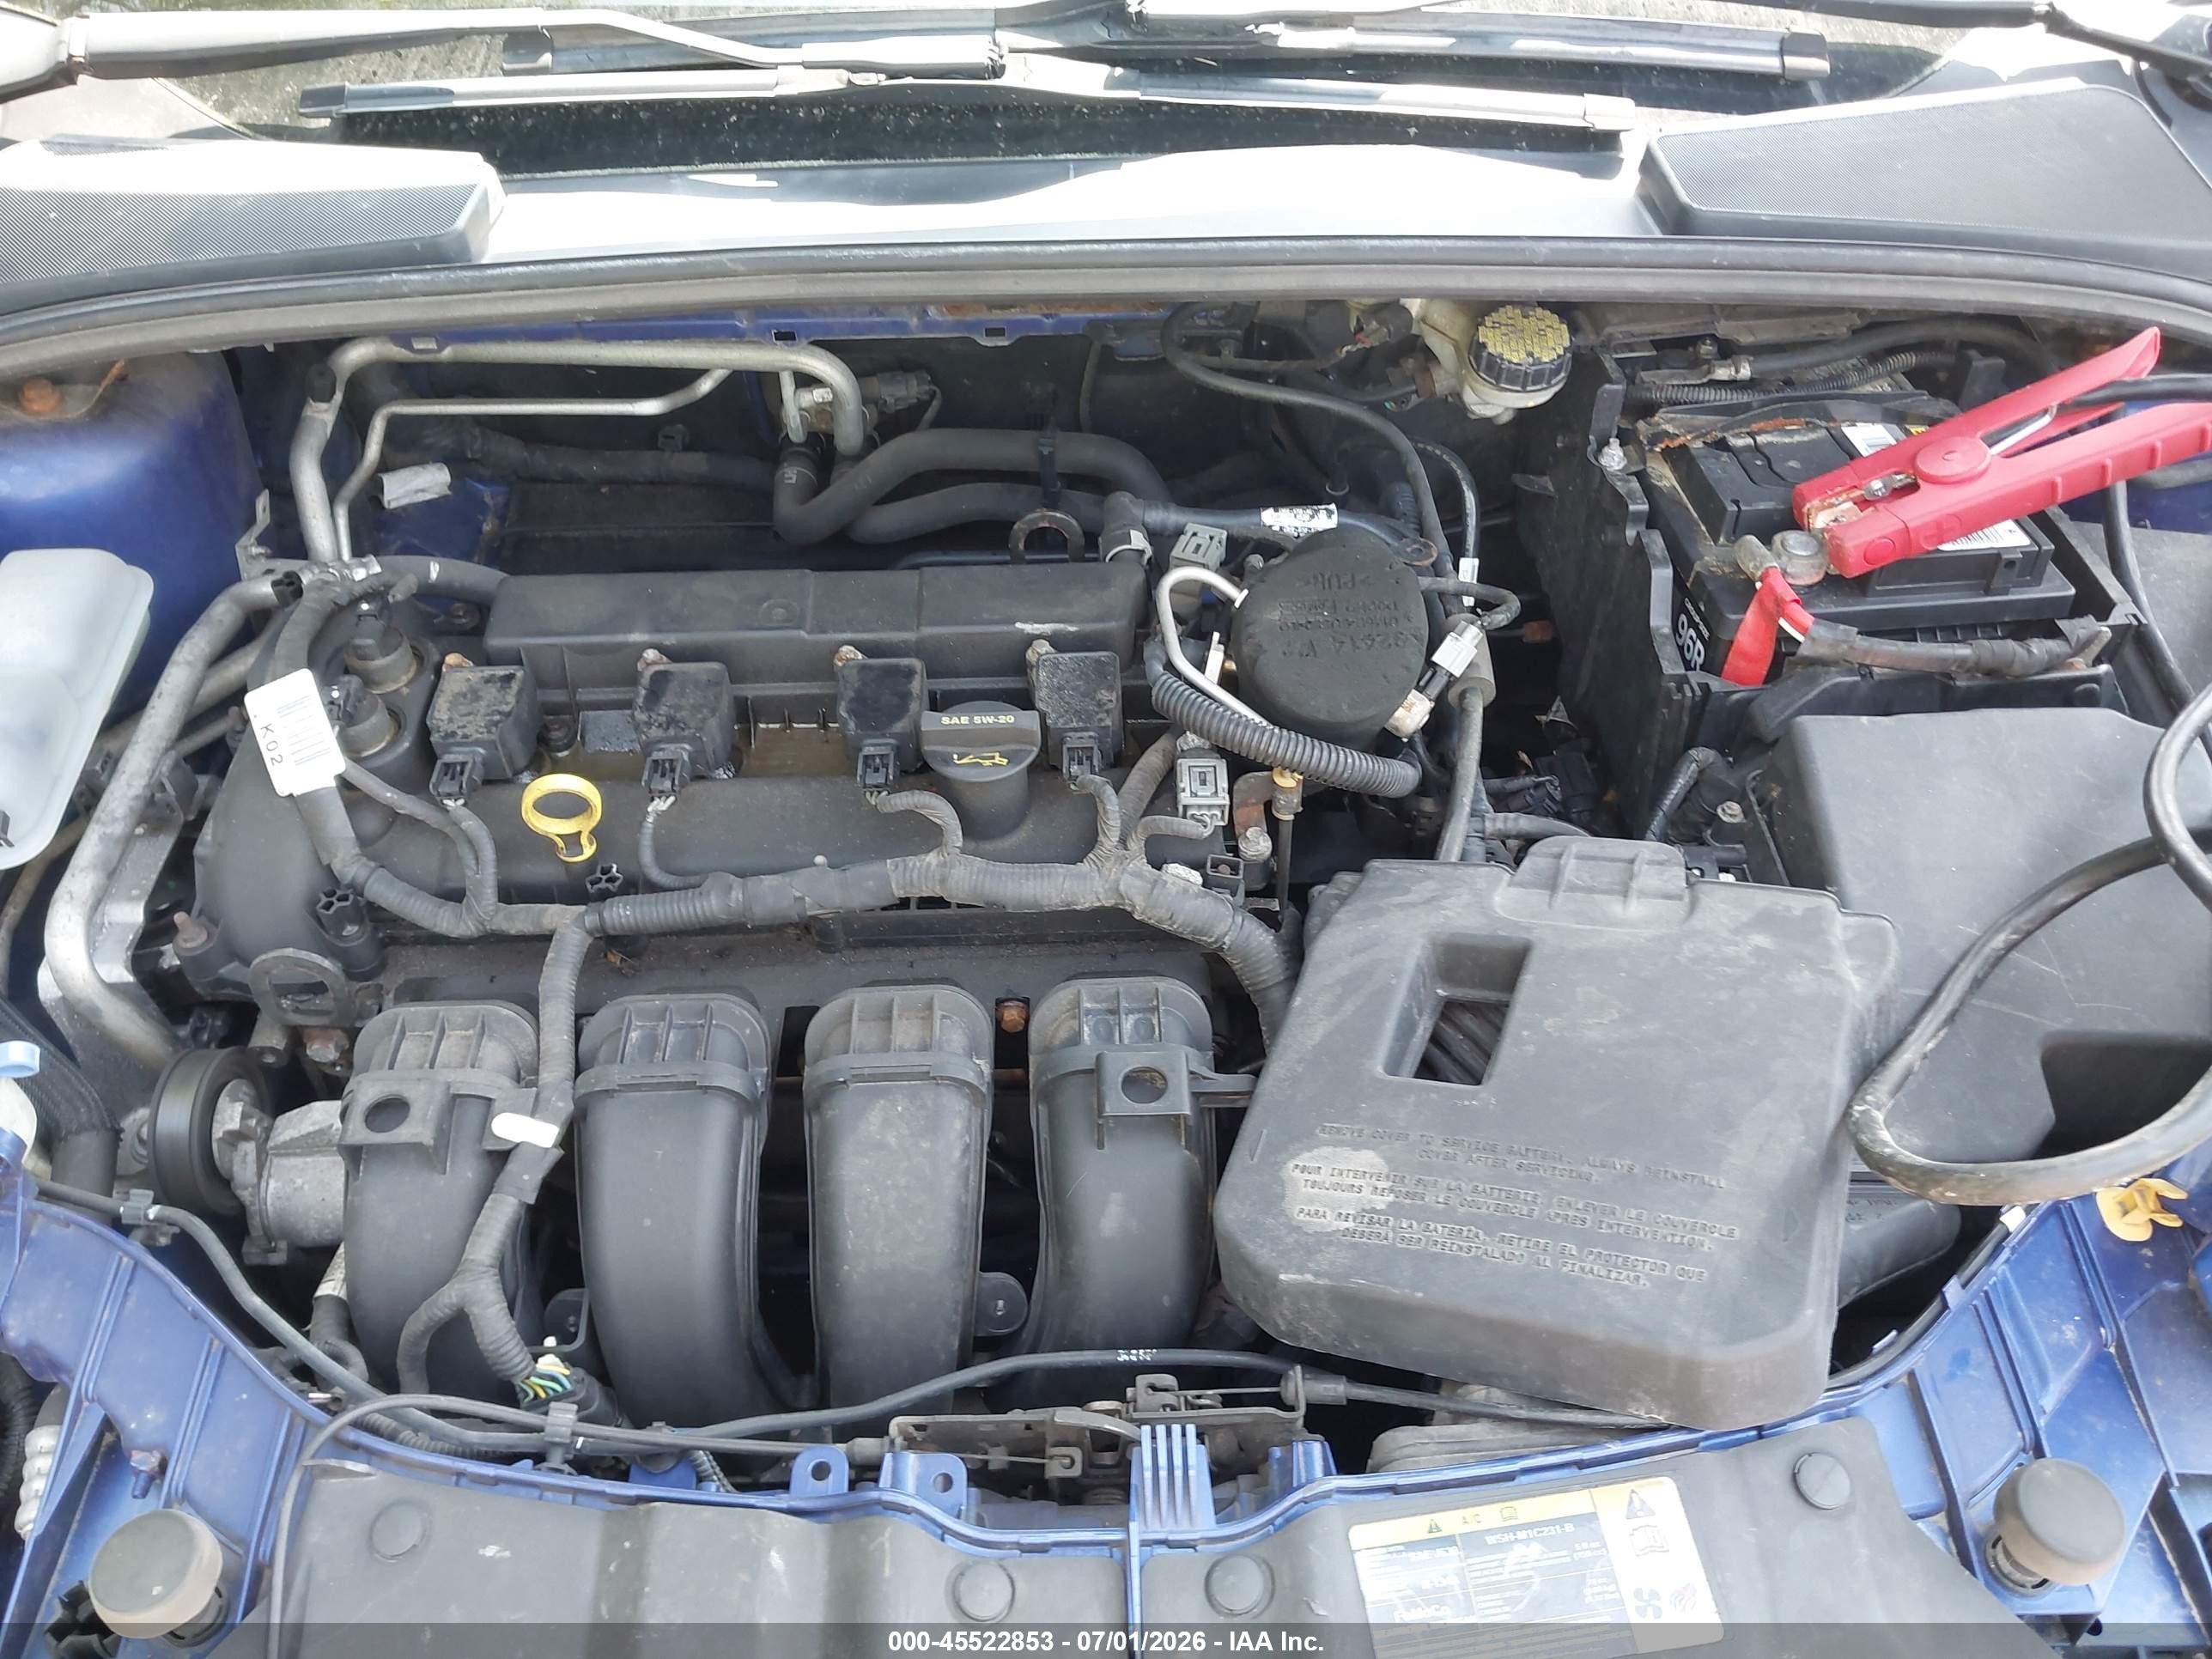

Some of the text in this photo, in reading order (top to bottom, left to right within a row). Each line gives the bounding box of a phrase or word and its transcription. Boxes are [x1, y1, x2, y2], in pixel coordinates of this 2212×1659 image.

[1676, 614, 1705, 670] 96R
[261, 723, 283, 766] K02
[941, 714, 1015, 725] SAE 5W-20
[1291, 1164, 1322, 1175] POUR
[1330, 1167, 1406, 1185] INTERVENIR
[1626, 1209, 1645, 1222] LE
[1654, 1214, 1738, 1238] COUVERCLE
[1304, 1179, 1363, 1194] TOUJOURS
[1460, 1197, 1537, 1218] COUVERCLE
[1297, 1207, 1328, 1219] PARA
[1335, 1212, 1391, 1227] REVISAR
[1401, 1218, 1415, 1231] LA
[1498, 1233, 1551, 1252] RETIRE
[1559, 1244, 1577, 1257] EL
[1586, 1249, 1668, 1273] PROTECTOR
[1676, 1267, 1706, 1282] QUE
[1398, 1234, 1422, 1246] SER
[1430, 1239, 1525, 1262] REINSTALADO
[1534, 1256, 1551, 1269] AL
[1560, 1261, 1648, 1287] FINALIZAR.
